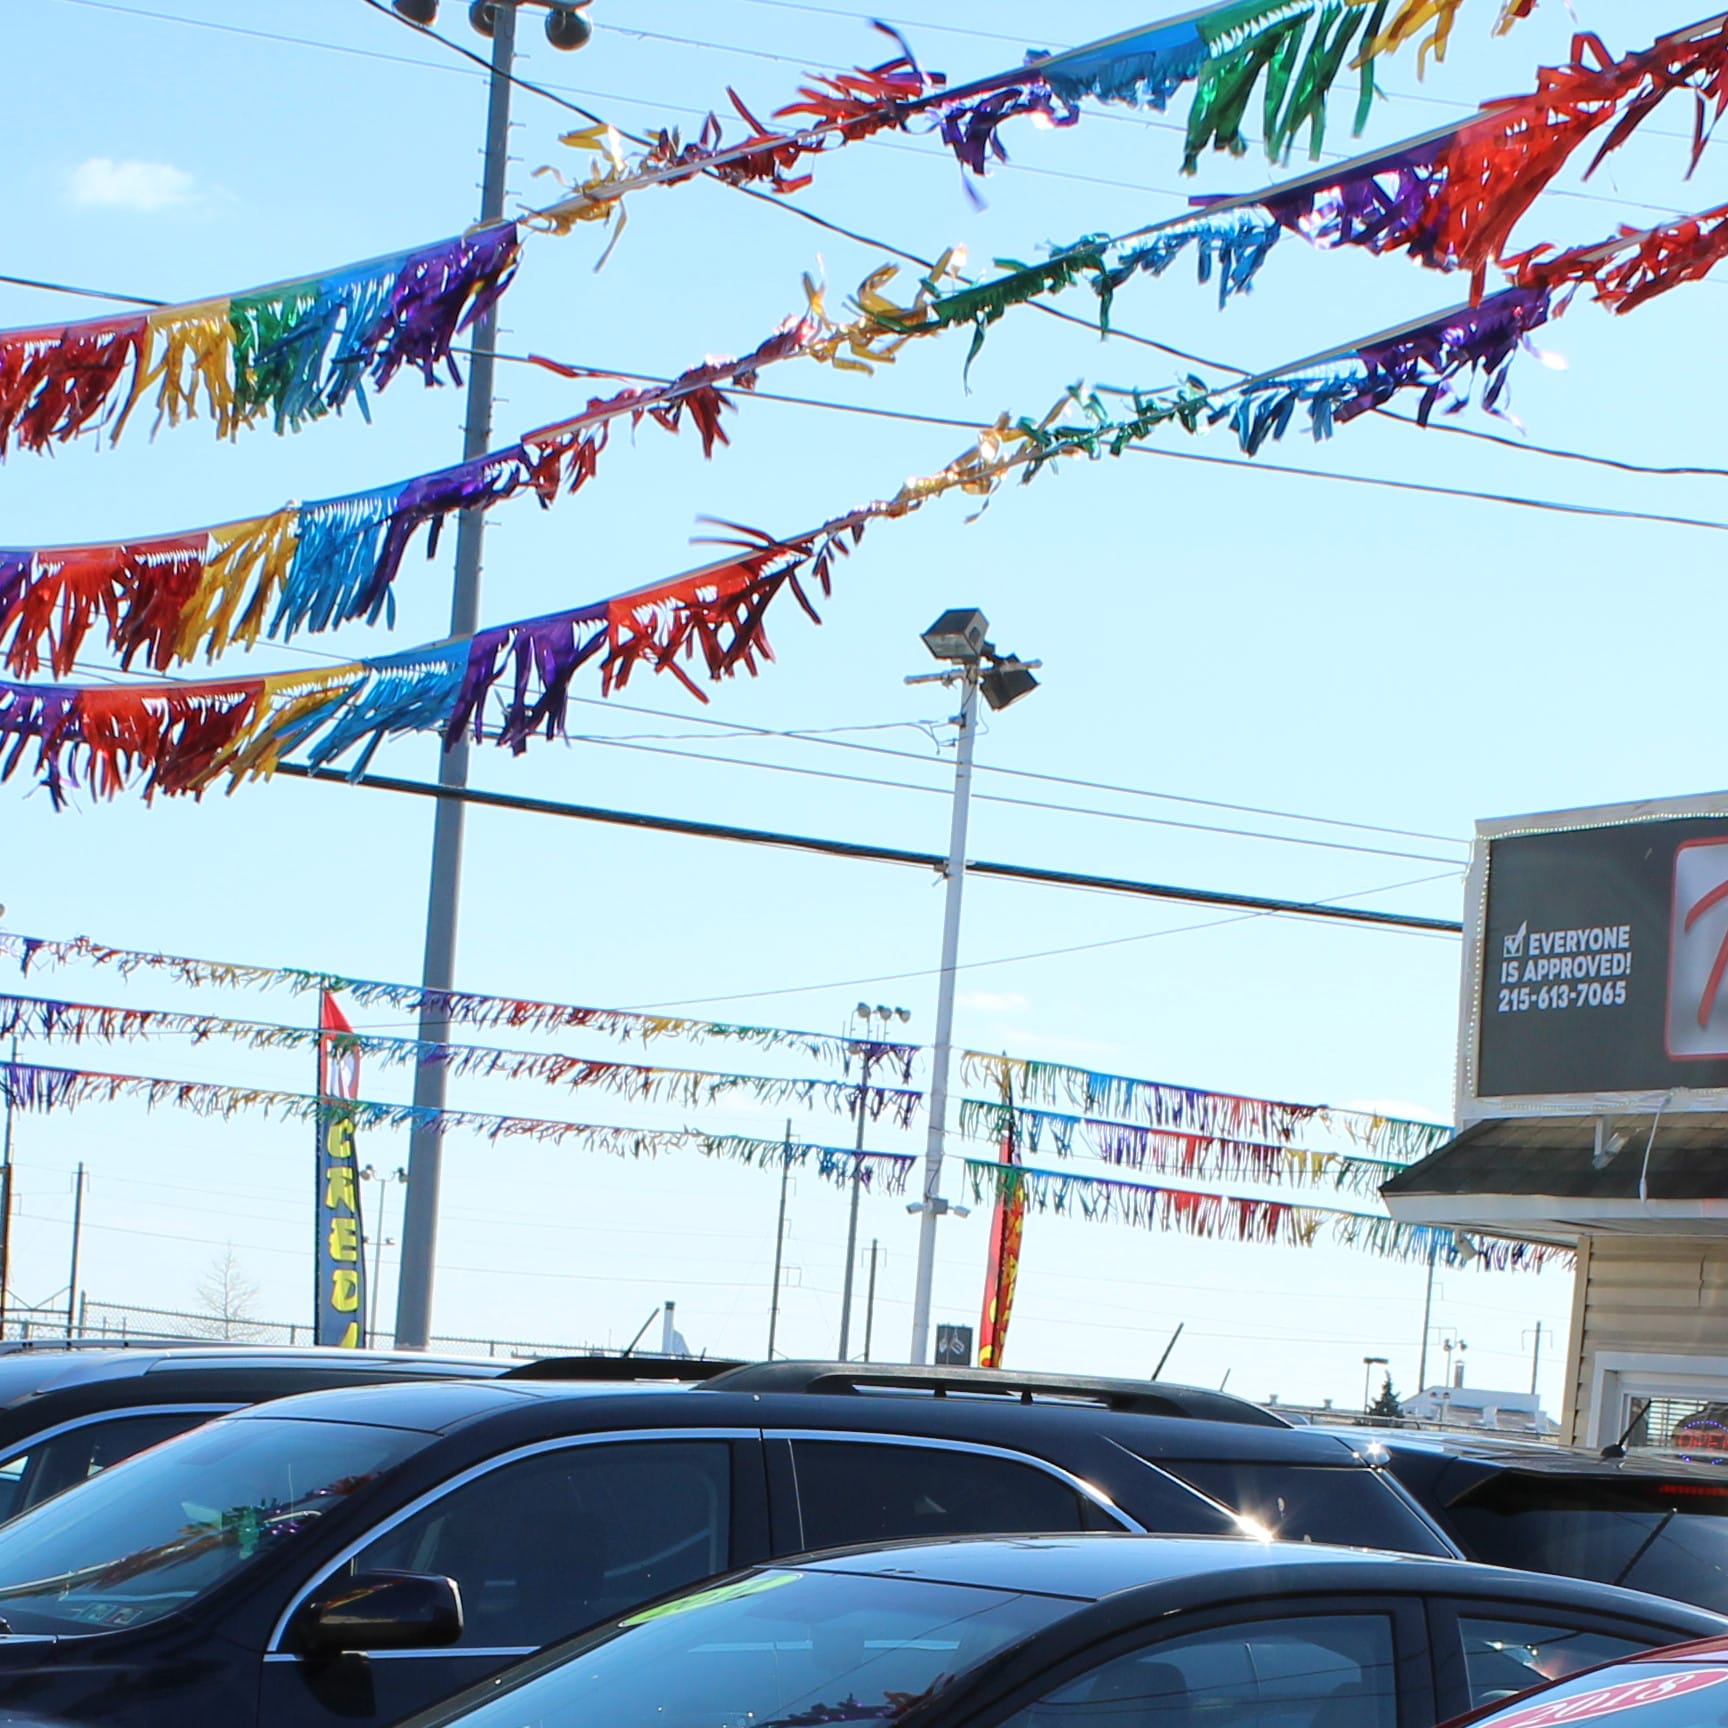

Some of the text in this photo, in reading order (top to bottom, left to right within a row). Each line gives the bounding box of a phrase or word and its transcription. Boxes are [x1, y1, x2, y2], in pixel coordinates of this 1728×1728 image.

[1528, 925, 1631, 956] EVERYONE
[1501, 952, 1632, 984] IS APPROVED!
[1498, 980, 1626, 1013] 215-613-7065
